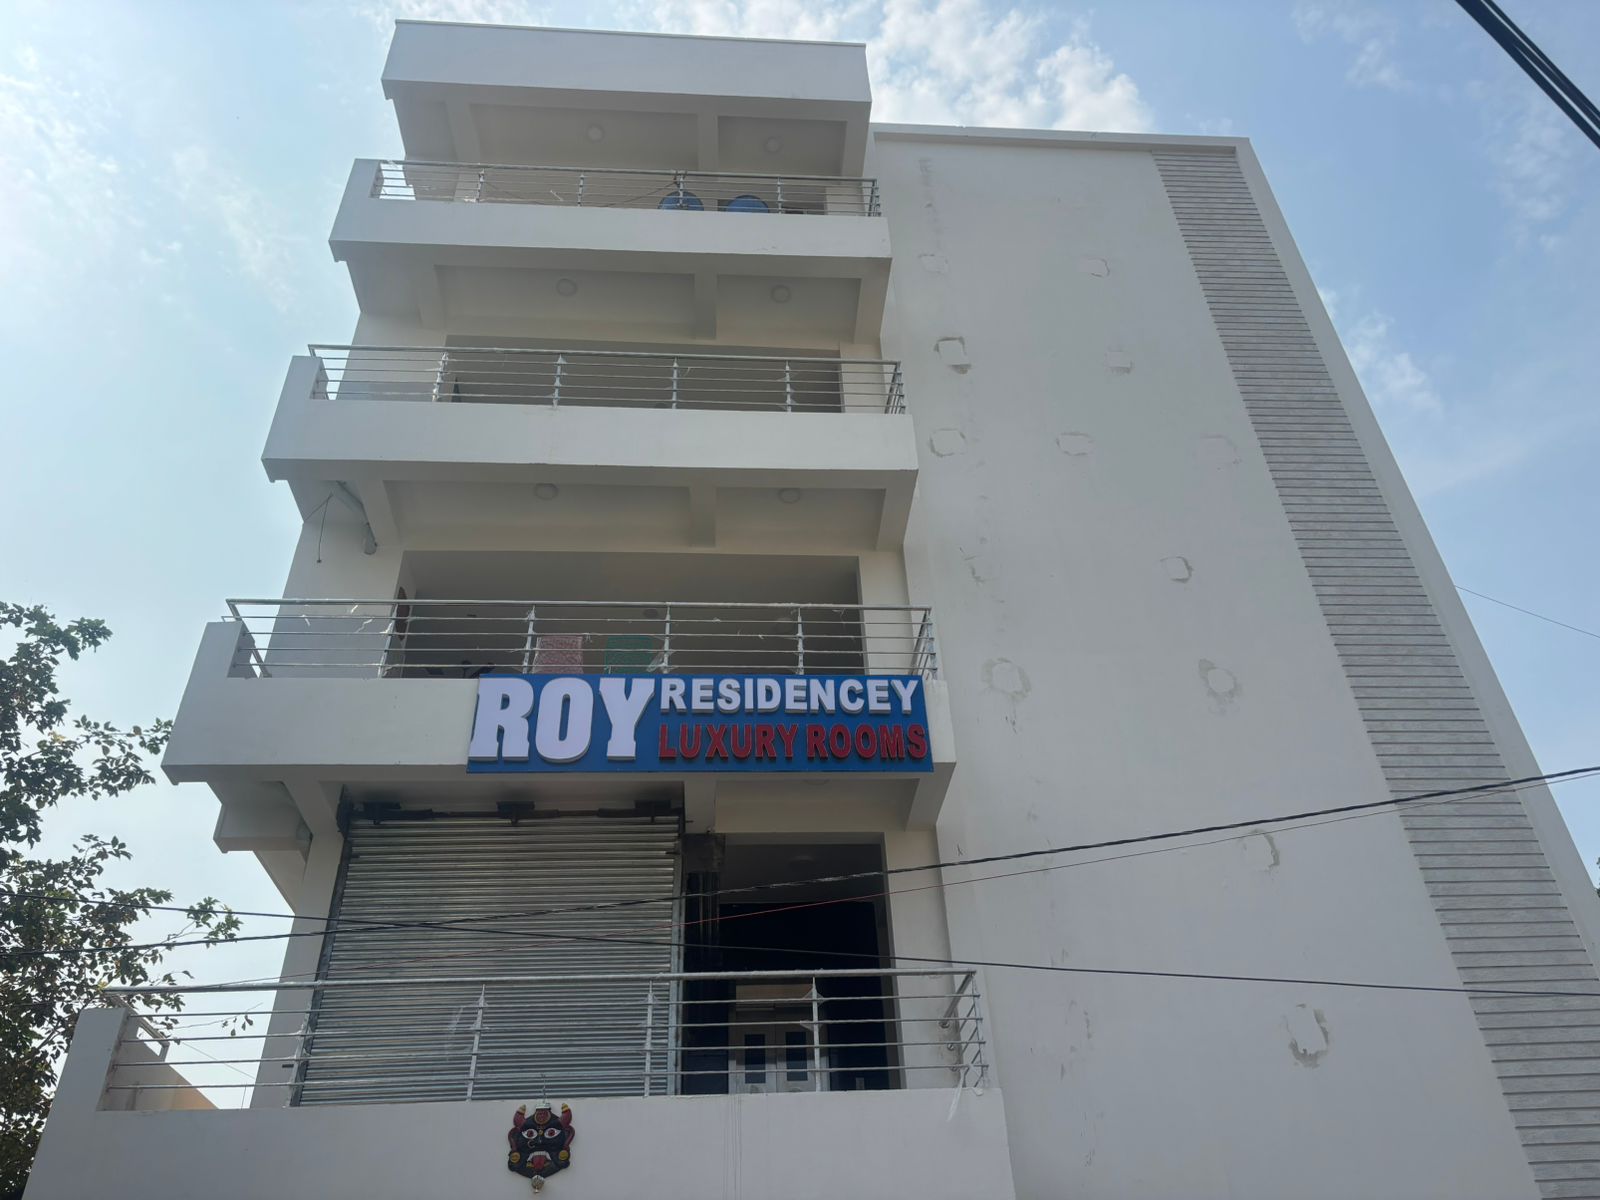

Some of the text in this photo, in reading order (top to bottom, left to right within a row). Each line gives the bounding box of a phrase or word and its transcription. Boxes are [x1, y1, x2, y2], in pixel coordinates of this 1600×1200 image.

[468, 677, 919, 763] ROY RESIDENCEY
[658, 723, 928, 760] LUXURY ROOMS
